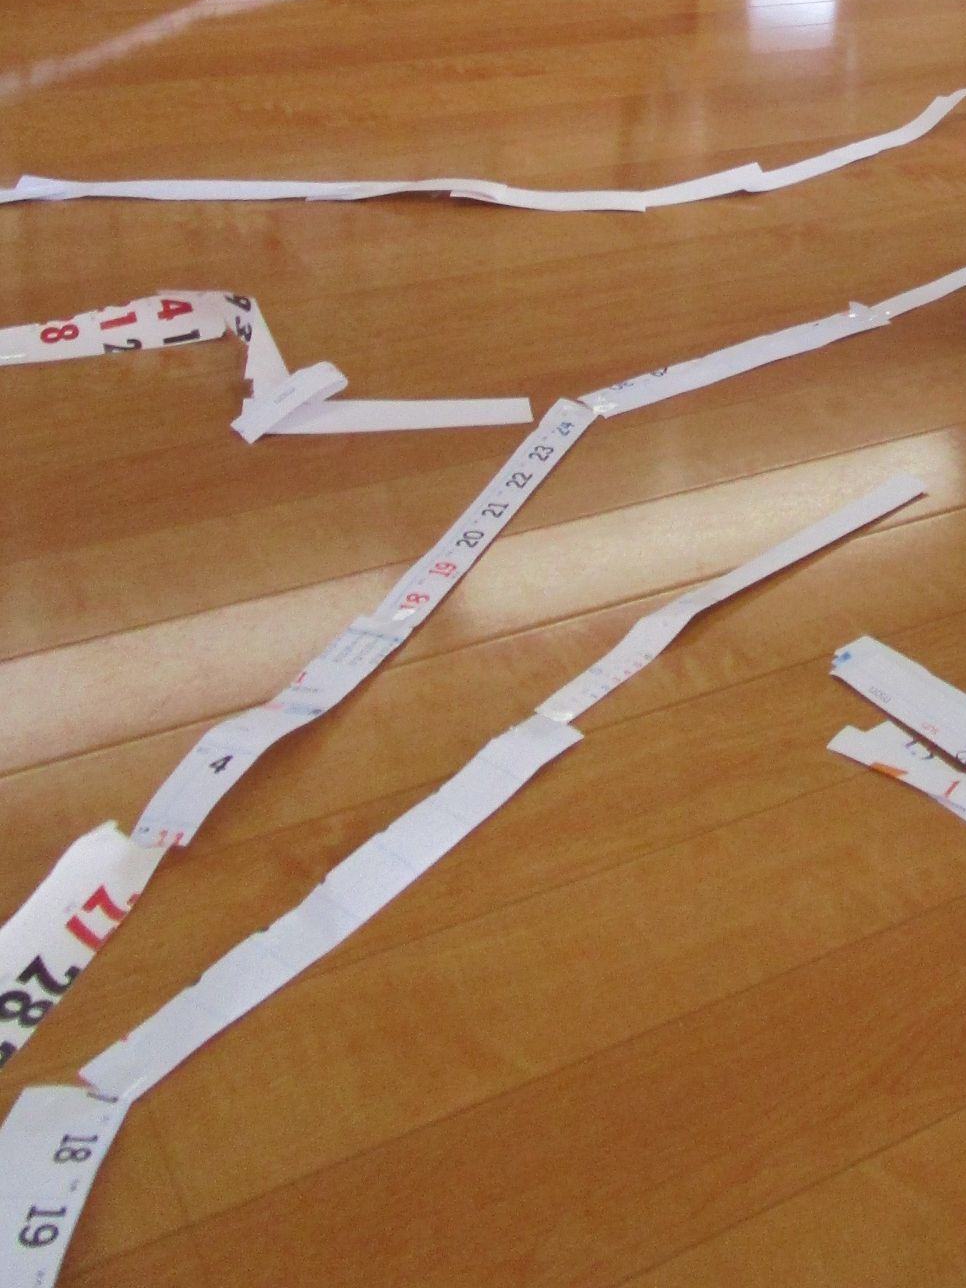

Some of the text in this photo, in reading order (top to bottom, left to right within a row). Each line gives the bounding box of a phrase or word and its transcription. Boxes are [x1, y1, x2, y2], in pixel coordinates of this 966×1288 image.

[428, 561, 457, 578] 19
[456, 529, 484, 549] 20
[481, 500, 510, 519] 21
[505, 471, 533, 490] 22
[528, 444, 555, 463] 23
[556, 420, 576, 437] 24
[210, 754, 234, 774] 4
[53, 1133, 98, 1164] 18
[18, 1204, 67, 1249] 19
